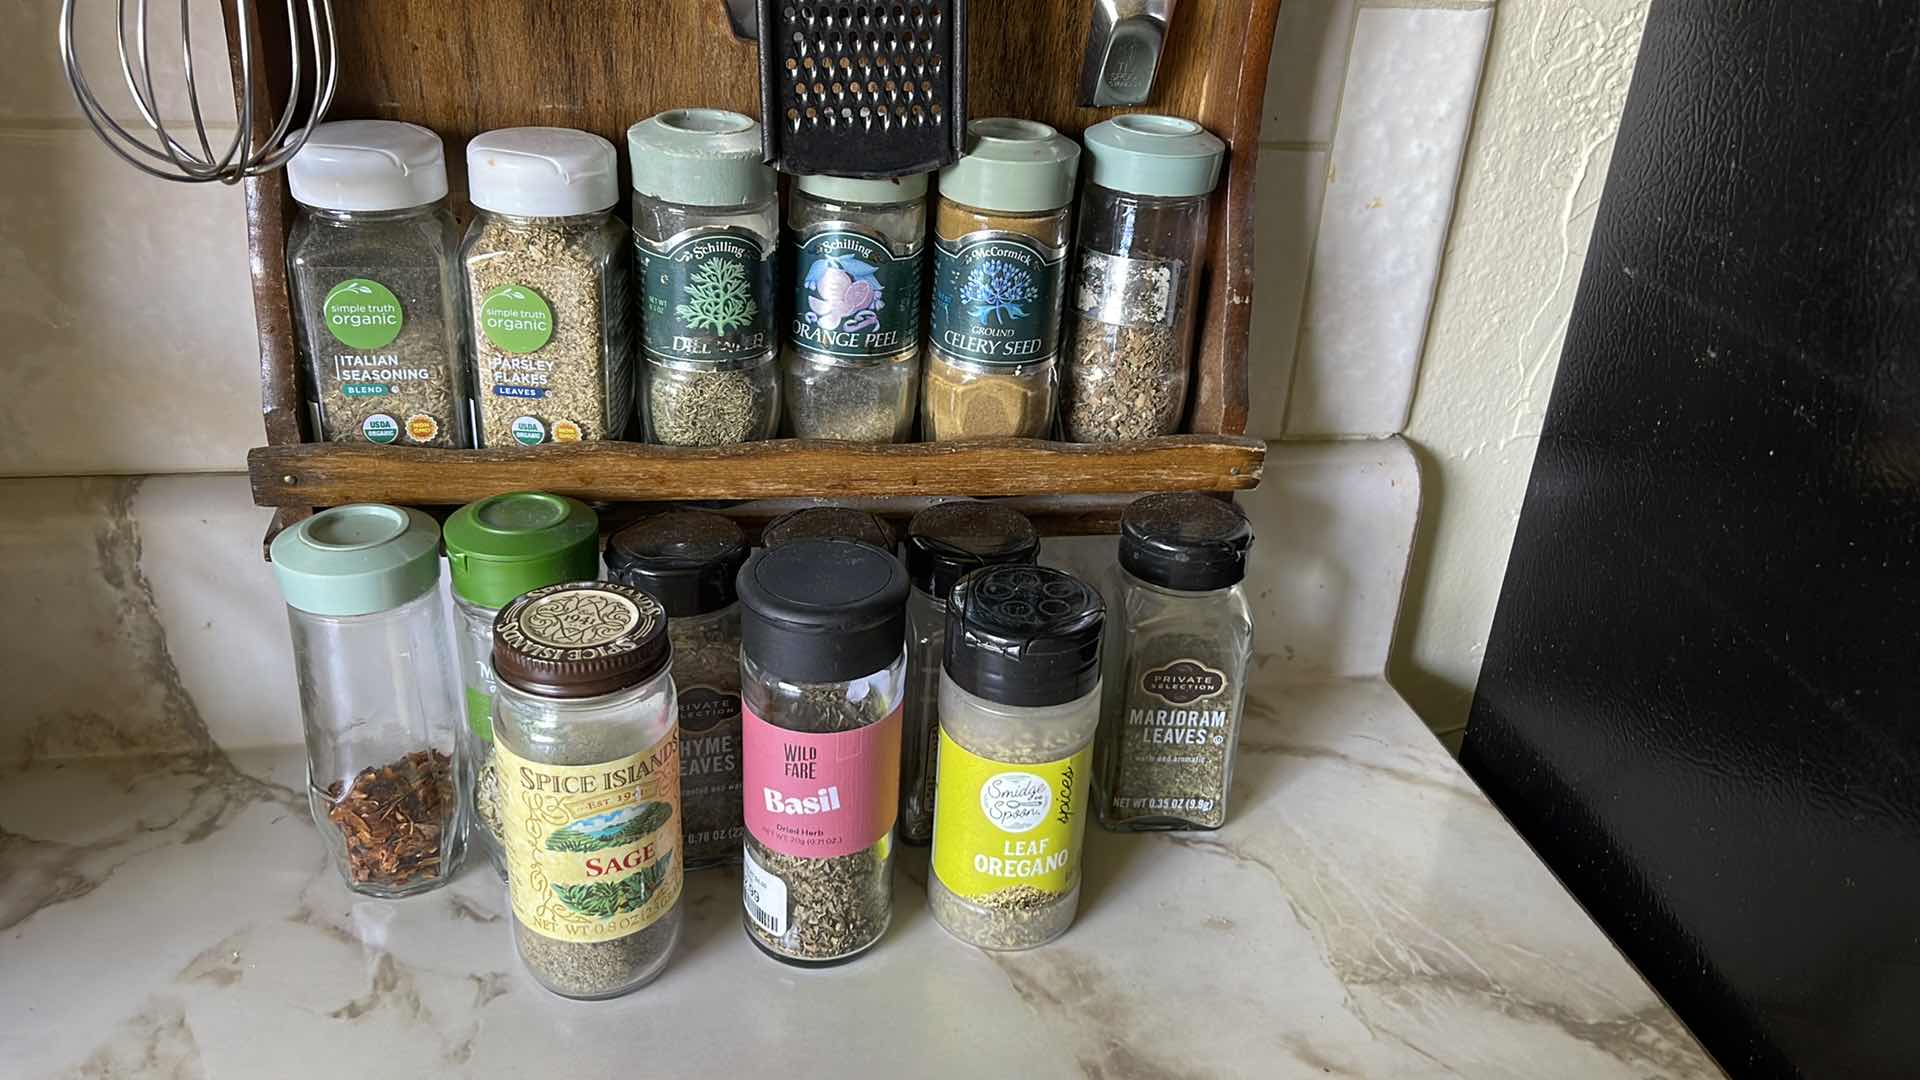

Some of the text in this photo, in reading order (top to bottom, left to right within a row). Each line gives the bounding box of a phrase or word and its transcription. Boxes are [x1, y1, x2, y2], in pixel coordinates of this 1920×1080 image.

[693, 242, 744, 258] Schilling
[822, 240, 872, 257] Schilling
[975, 247, 1031, 266] McCormick
[331, 302, 395, 314] simple truth
[487, 308, 545, 319] simple truth
[332, 313, 397, 327] organic
[487, 317, 547, 332] organic
[792, 320, 898, 348] ORANGE PEEL
[972, 325, 1015, 337] GROUND
[944, 329, 1042, 356] CELERY SEED
[340, 355, 398, 367] ITALIAN
[494, 358, 554, 371] PARSLEY
[341, 368, 429, 381] SEASONING
[495, 372, 548, 384] FLAKES
[348, 386, 382, 394] BLEND
[499, 388, 536, 396] LEAVES
[567, 637, 637, 661] SPICE
[1151, 683, 1215, 691] SELECTION
[1154, 675, 1213, 684] PRIVATE
[680, 699, 730, 711] RIVATE
[1129, 709, 1227, 728] MARJORAM
[1143, 728, 1208, 745] LEAVES
[681, 735, 733, 757] HYME
[784, 743, 817, 762] WILD
[519, 728, 678, 795] SPICE ISLANDS
[679, 755, 736, 776] EAVES
[785, 762, 817, 780] FARE
[763, 786, 841, 816] Basil
[1057, 766, 1075, 824] spices
[1112, 798, 1130, 809] NET
[1133, 799, 1148, 809] WT
[1149, 798, 1170, 809] 0.35
[1171, 799, 1185, 809] OZ
[802, 828, 824, 837] Herb
[1004, 839, 1049, 857] LEAF
[585, 842, 656, 877] SAGE
[974, 849, 1069, 878] OREGANO
[566, 923, 591, 936] WT
